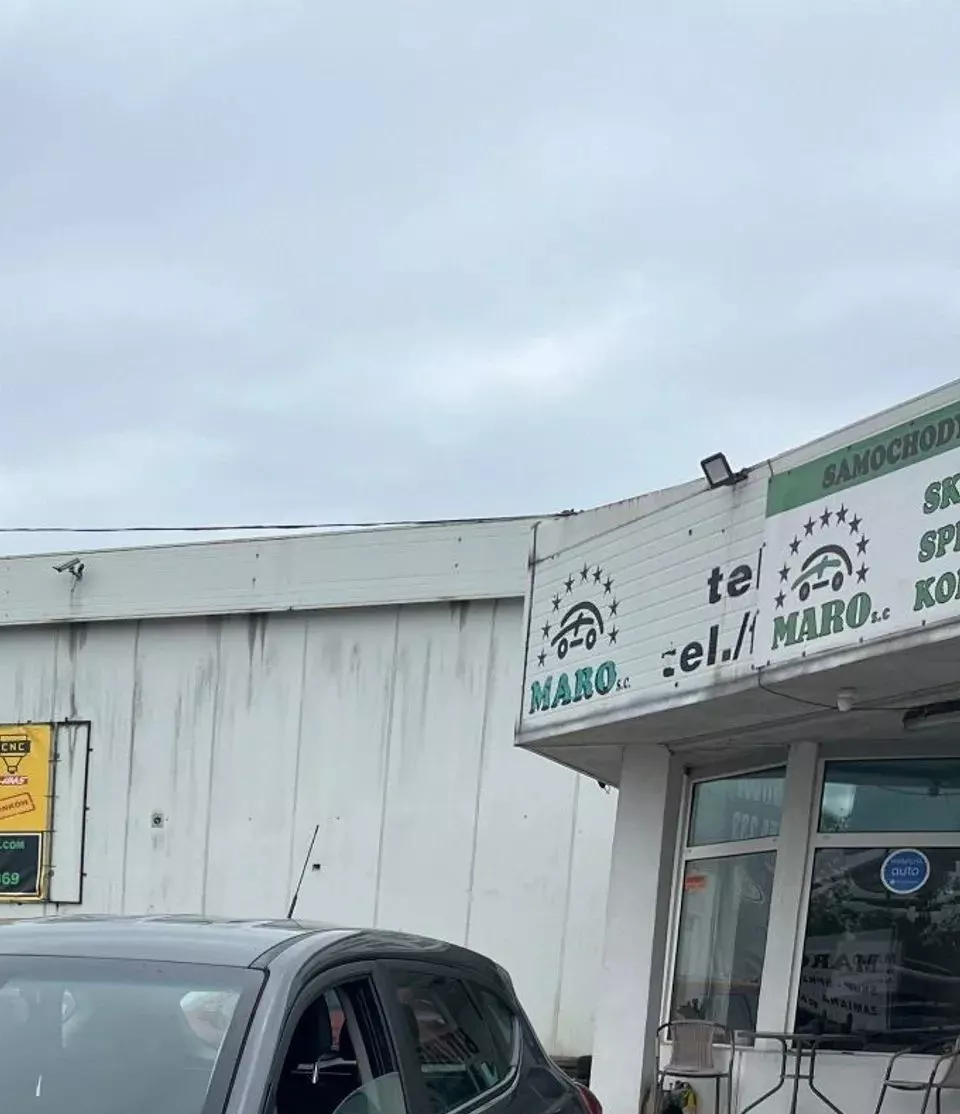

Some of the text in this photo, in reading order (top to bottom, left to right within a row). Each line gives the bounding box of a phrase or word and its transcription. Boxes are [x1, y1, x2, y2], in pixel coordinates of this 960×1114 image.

[913, 569, 960, 611] KO
[771, 592, 872, 650] MARO
[528, 660, 617, 715] MARO
[1, 742, 26, 752] CNC
